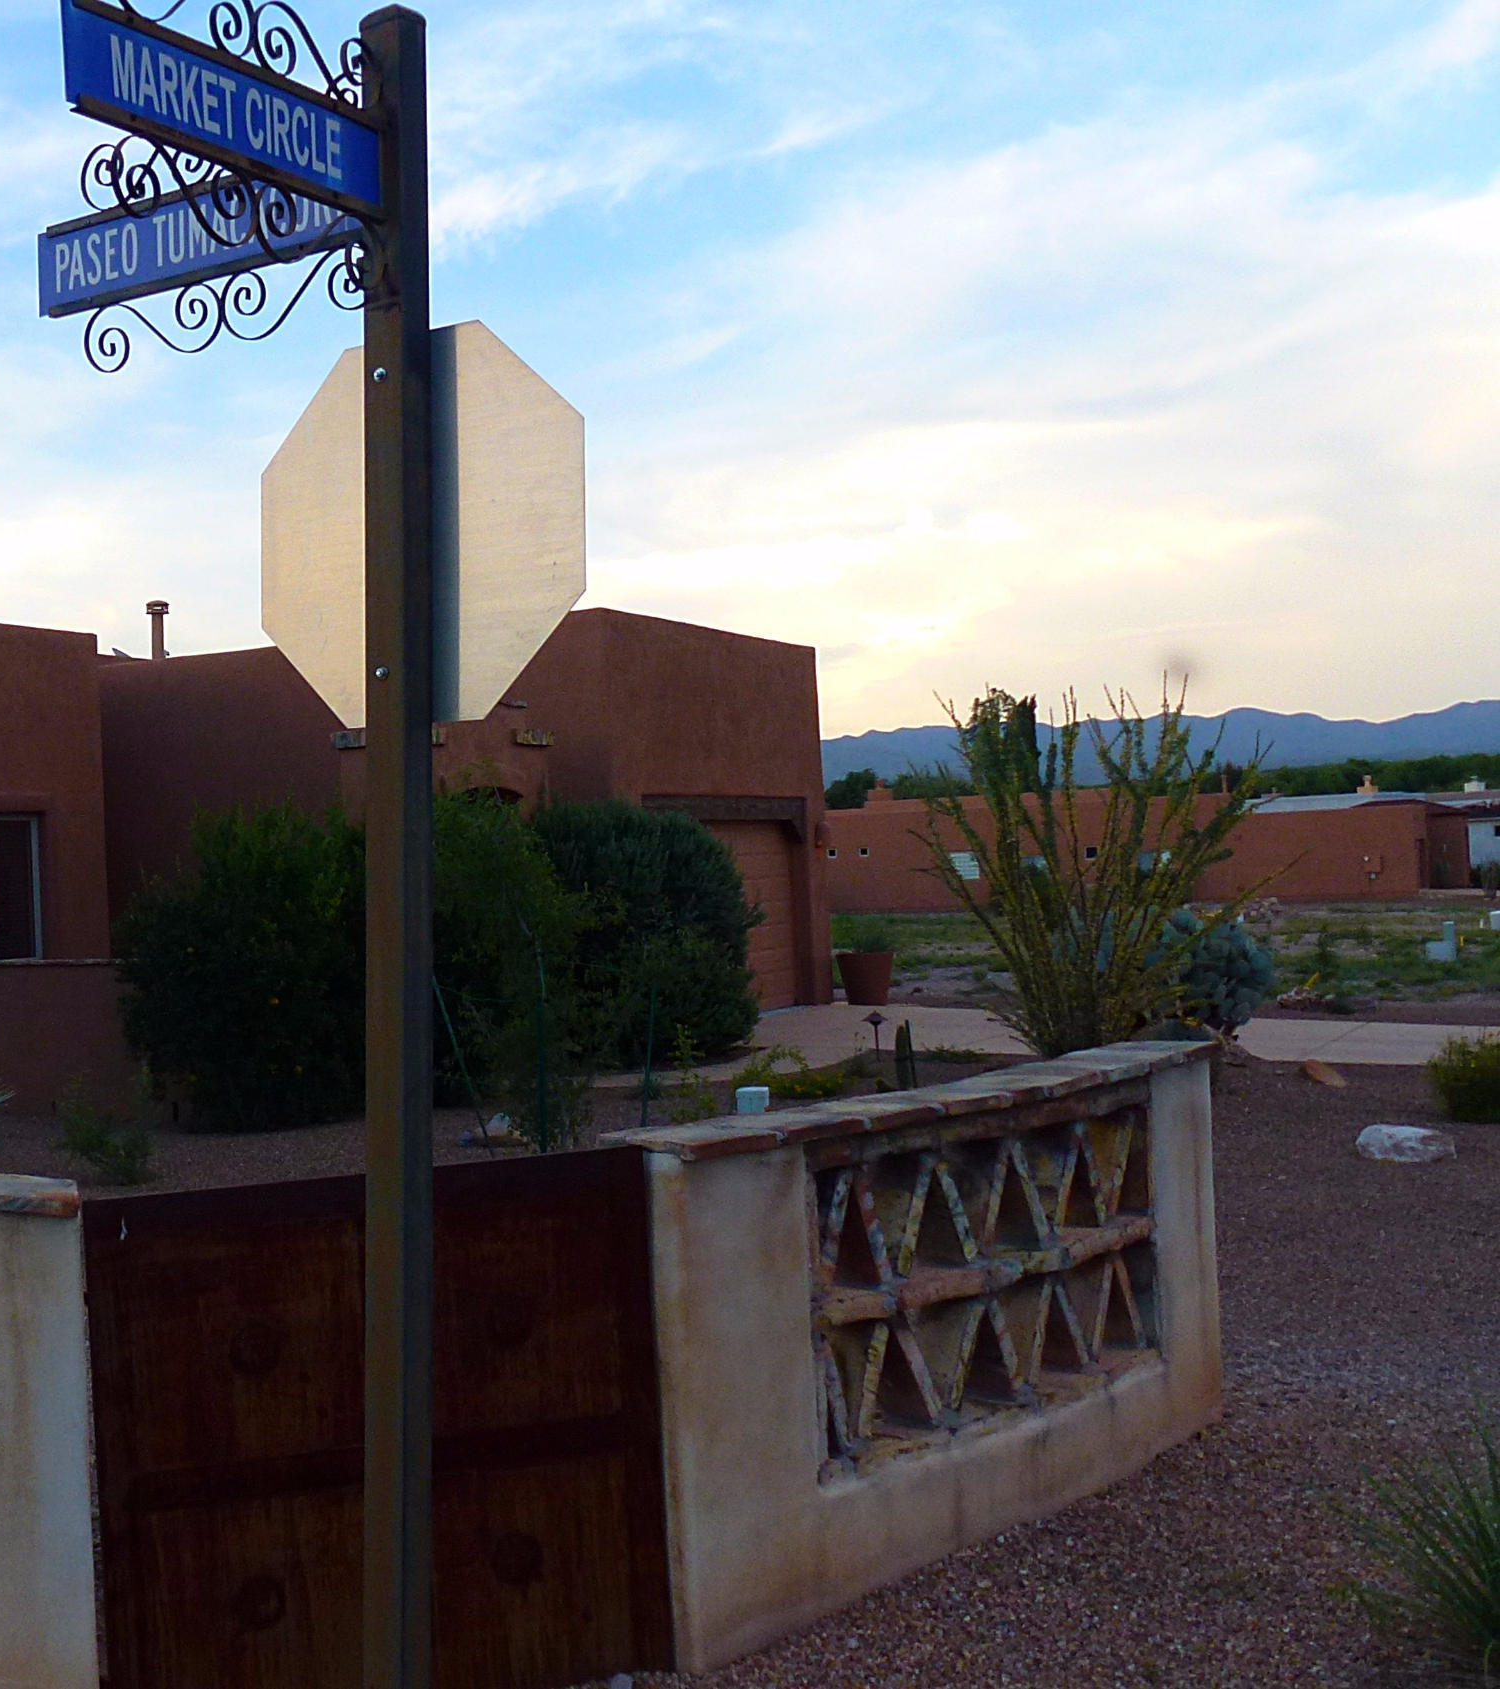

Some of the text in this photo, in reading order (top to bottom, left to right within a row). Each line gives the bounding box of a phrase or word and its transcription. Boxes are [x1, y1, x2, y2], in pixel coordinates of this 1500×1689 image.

[109, 33, 343, 181] MARKET CIRCLE
[54, 185, 344, 294] PASEO TUMACAO
